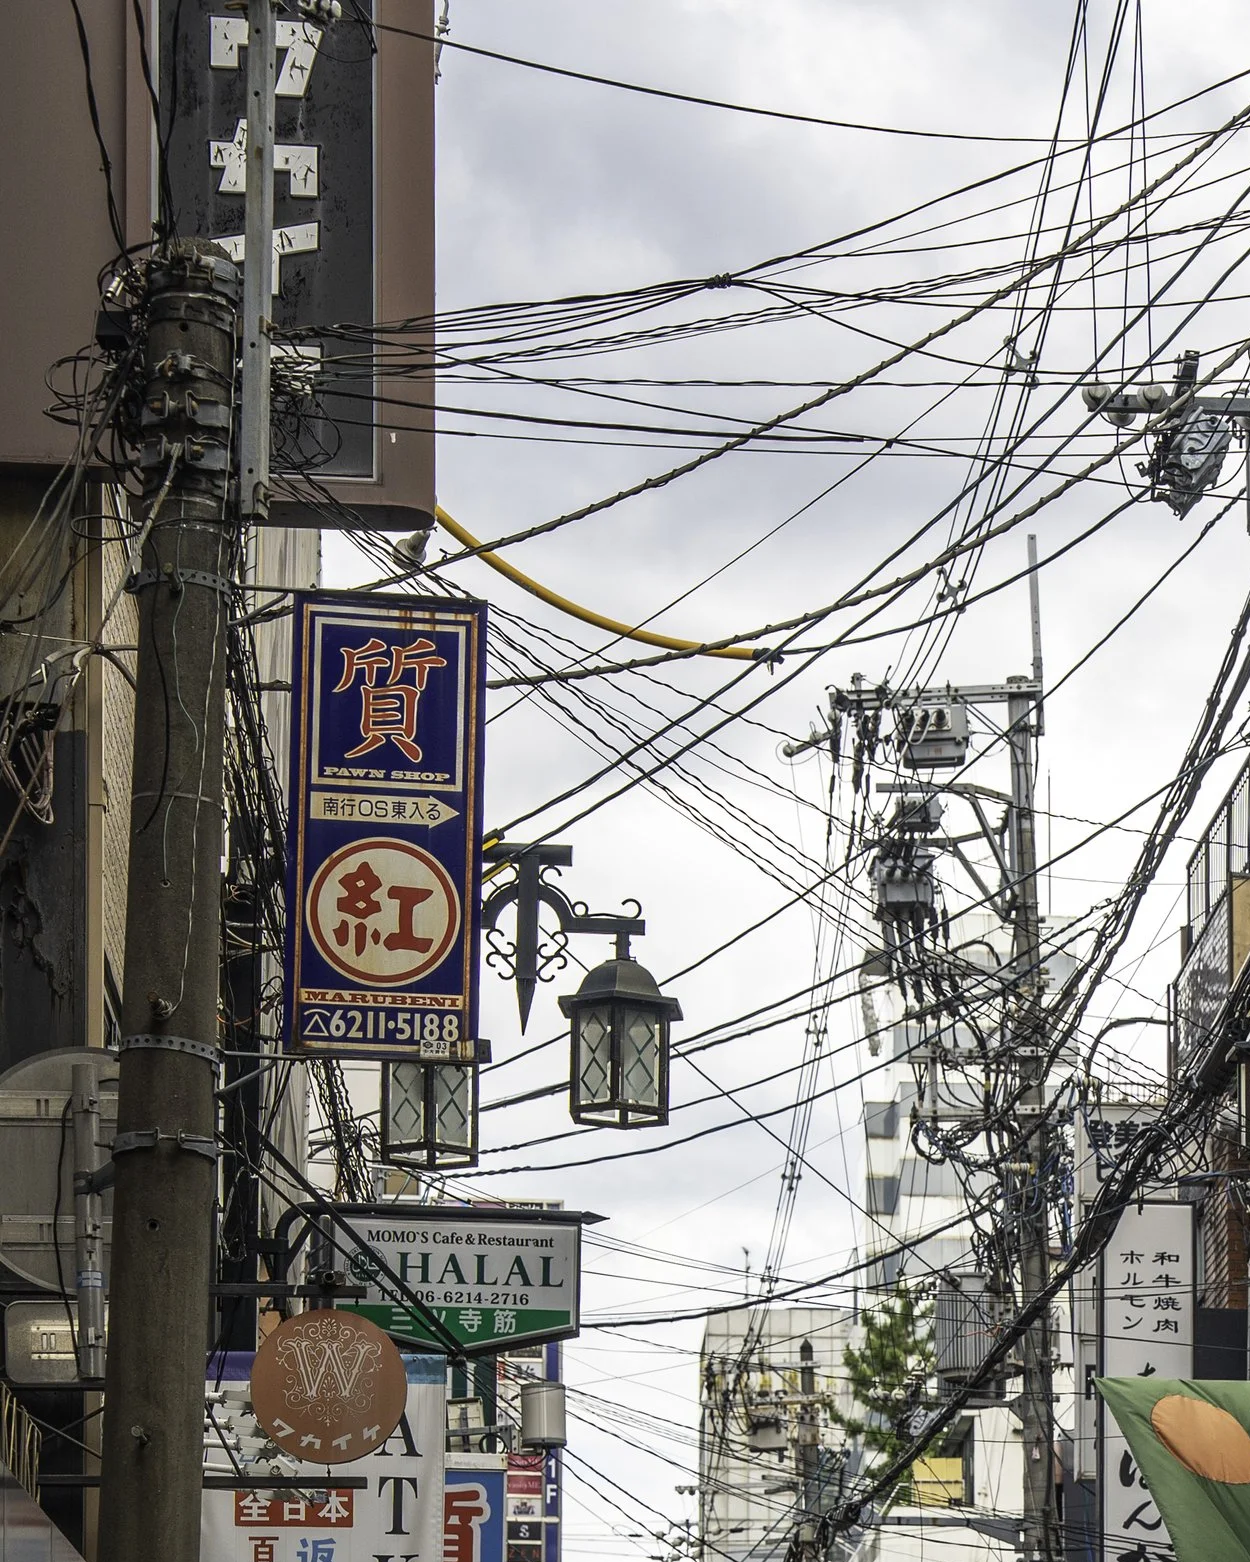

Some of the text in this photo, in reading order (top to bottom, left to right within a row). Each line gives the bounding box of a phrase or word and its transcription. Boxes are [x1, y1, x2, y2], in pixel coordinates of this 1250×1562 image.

[209, 15, 322, 376] ワカイ
[331, 637, 448, 763] 質
[323, 766, 450, 782] PAWN SHOP
[323, 797, 441, 821] 南行OS東入る
[332, 861, 434, 957] 紅
[305, 990, 459, 1008] MARUBENI
[433, 1232, 463, 1245] Cafe
[465, 1234, 476, 1245] &
[478, 1234, 554, 1248] Restaurant
[397, 1252, 564, 1287] HALAL
[414, 1291, 529, 1306] 06-6214-2716
[1120, 1250, 1146, 1330] ホルモン
[1152, 1251, 1181, 1333] 和牛焼肉
[390, 1307, 517, 1334] 三ツ寺筋
[272, 1418, 381, 1450] ワカイケ
[519, 1525, 529, 1537] S
